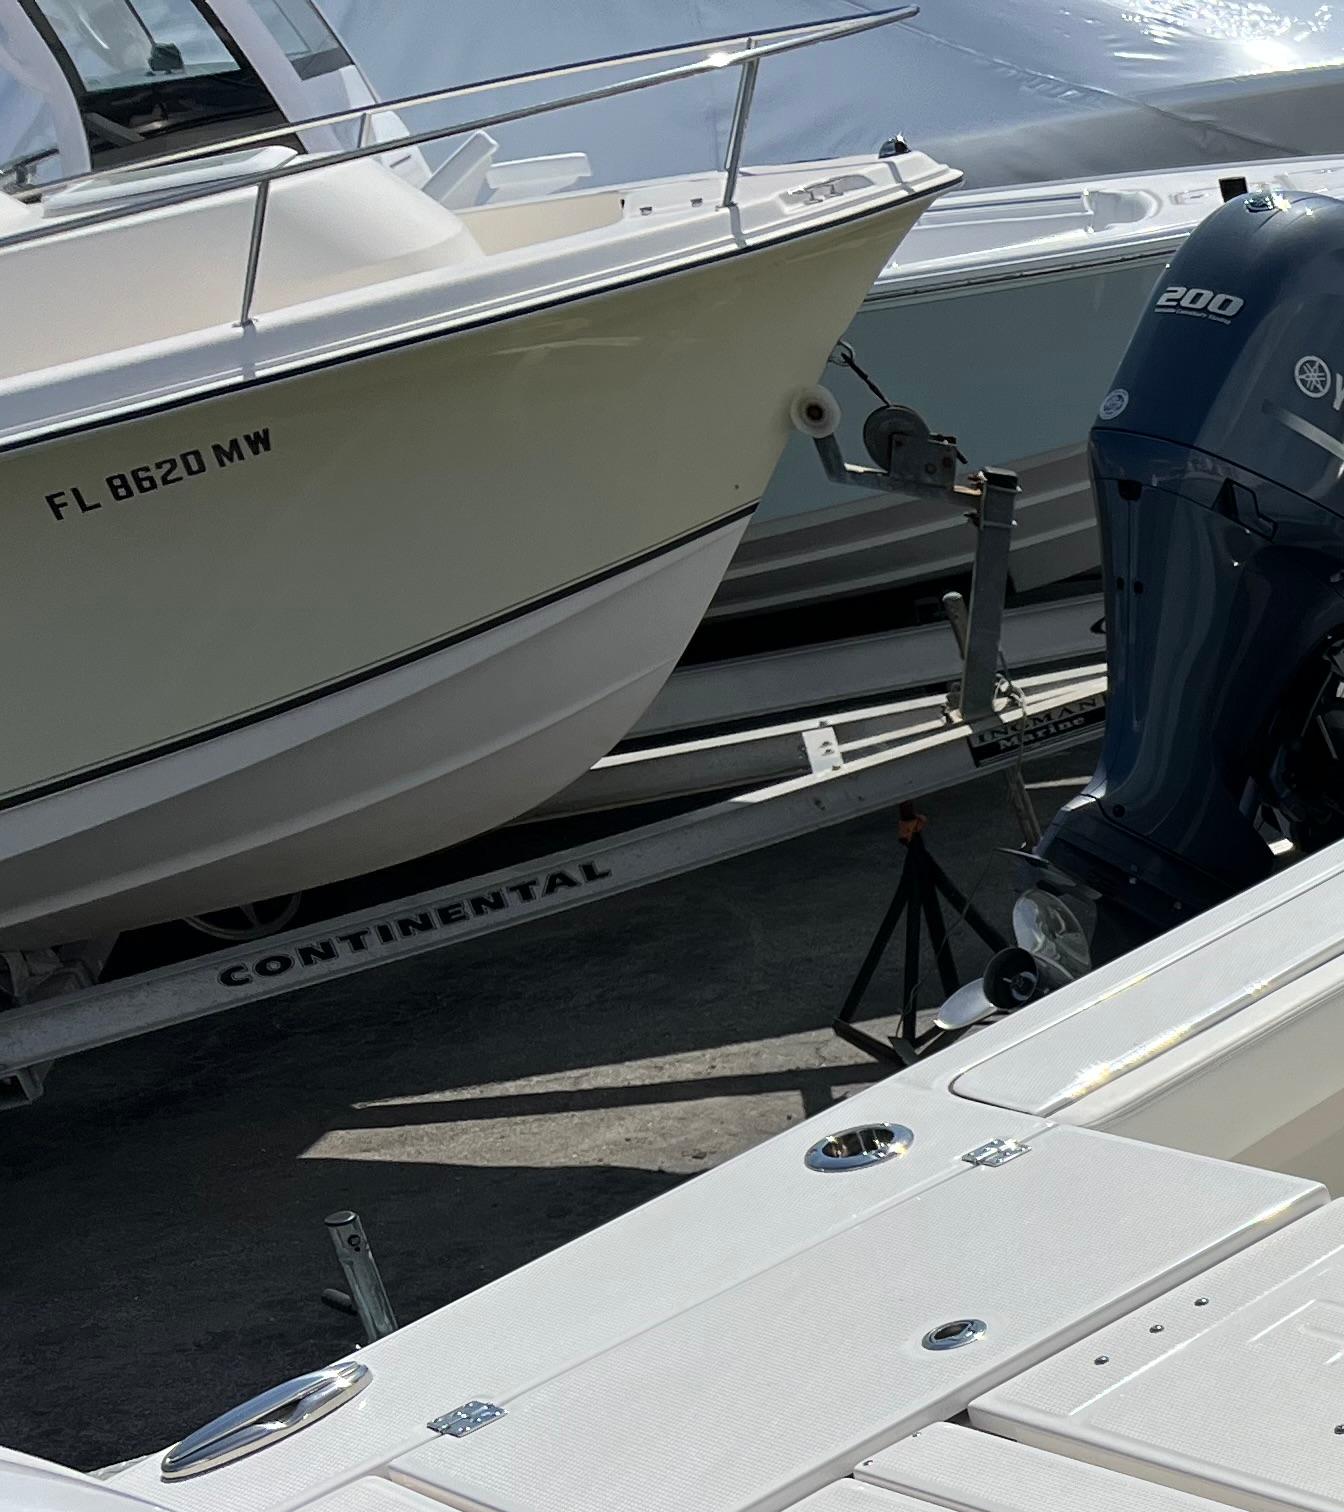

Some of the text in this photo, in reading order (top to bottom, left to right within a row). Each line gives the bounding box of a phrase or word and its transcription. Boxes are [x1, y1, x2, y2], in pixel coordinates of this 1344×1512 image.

[1157, 286, 1244, 317] 200
[45, 428, 272, 520] FL 8620 MW
[1001, 717, 1086, 750] Marine
[217, 860, 613, 989] CONTINENTAL
